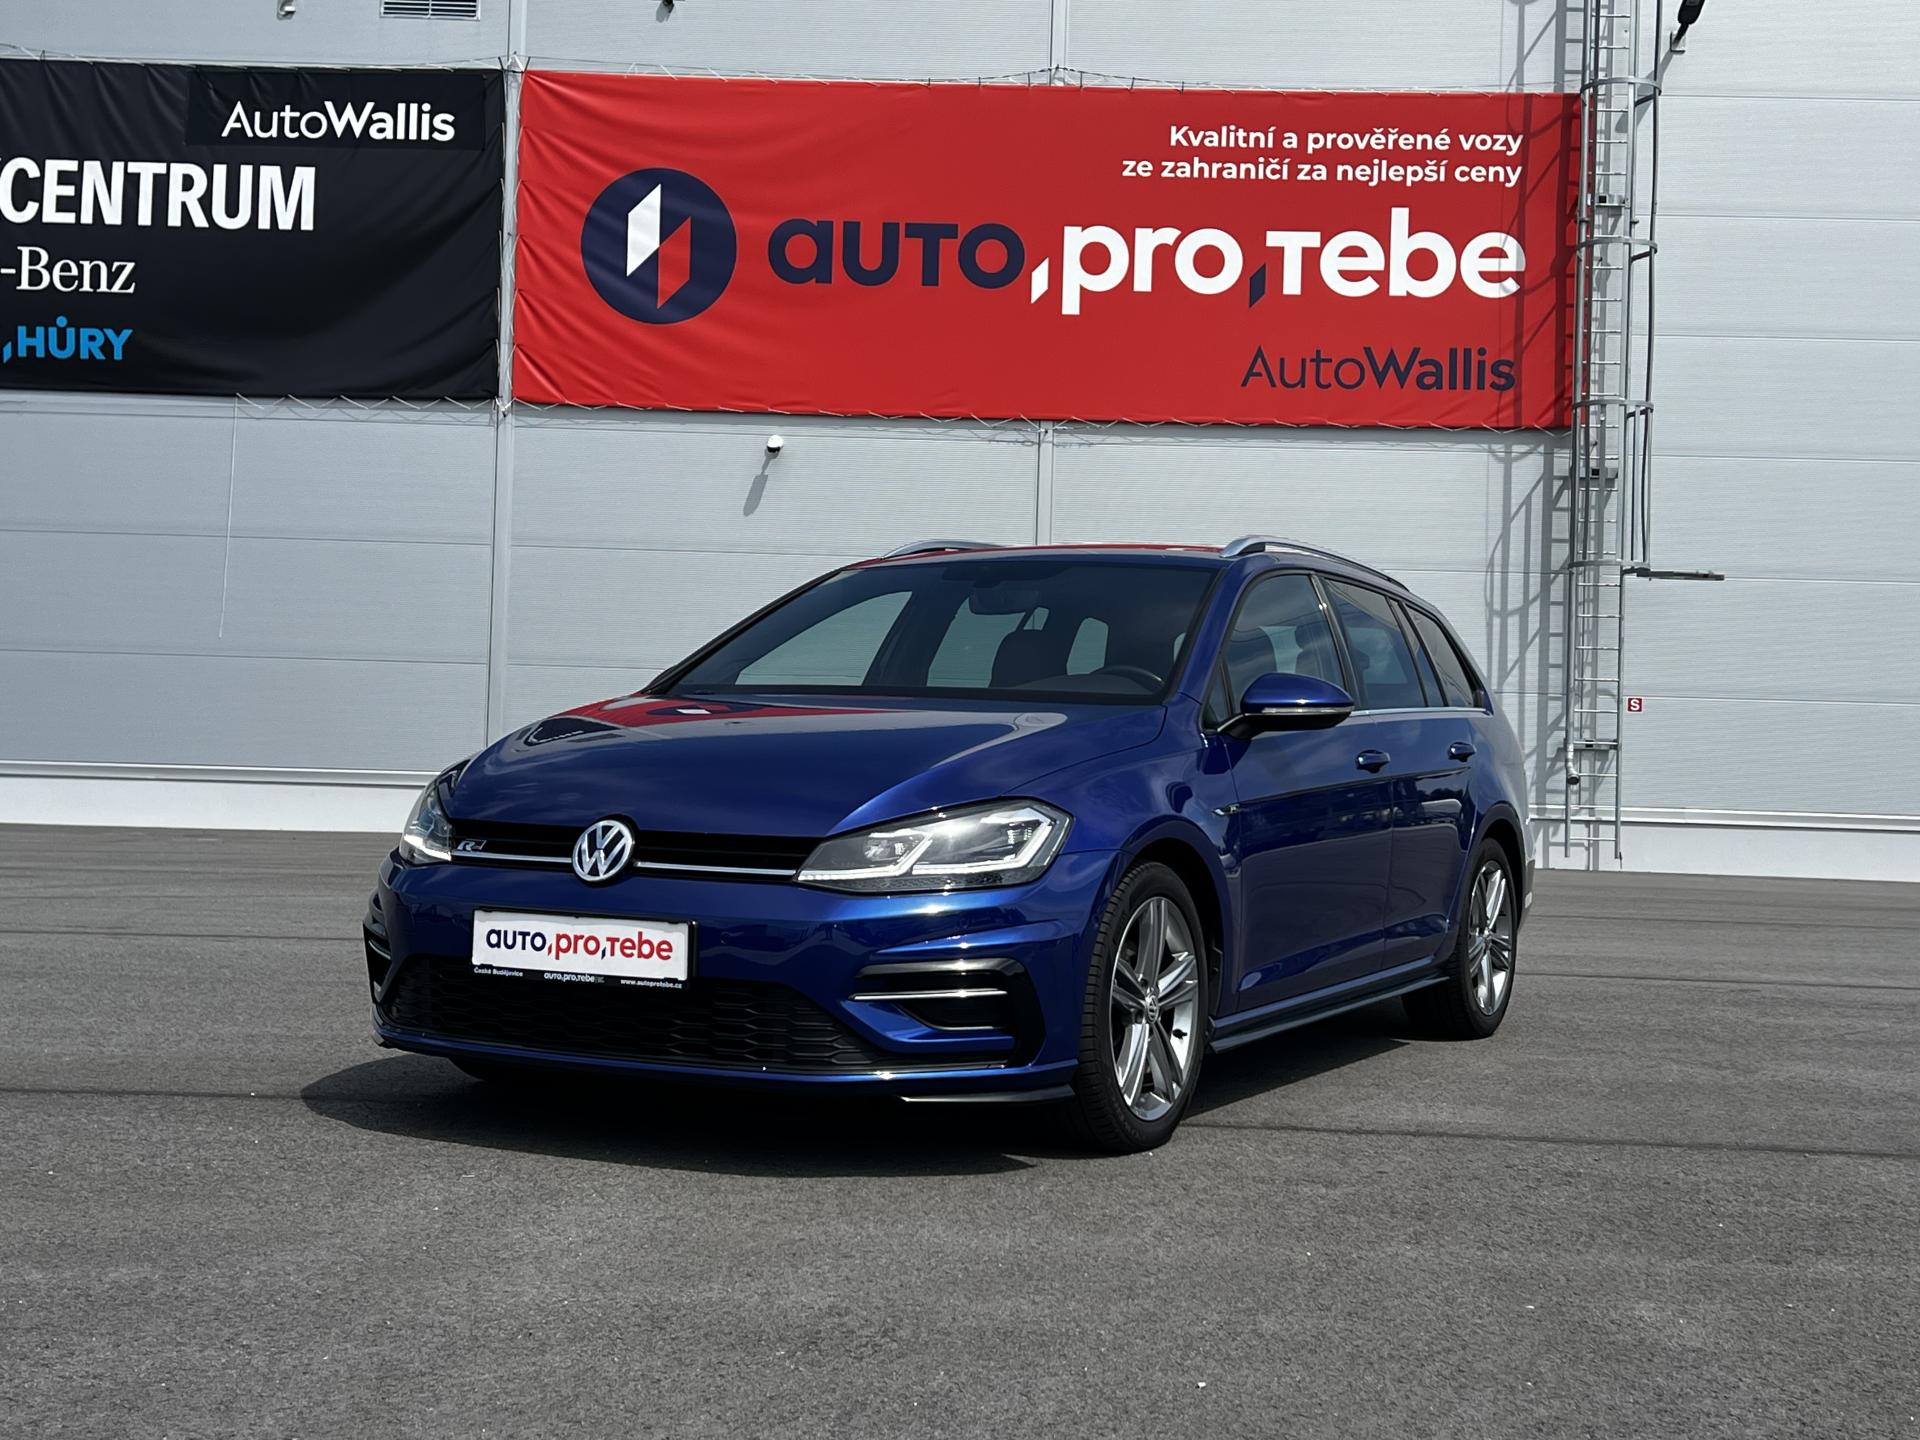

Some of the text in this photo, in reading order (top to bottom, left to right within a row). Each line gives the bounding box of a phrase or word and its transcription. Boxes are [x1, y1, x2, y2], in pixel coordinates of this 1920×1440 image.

[221, 100, 456, 142] AutoWallis
[1170, 125, 1524, 157] Kvalitní a prověřené vozy
[1121, 156, 1523, 188] ze zahraničí za nejlepší ceny
[0, 156, 316, 231] CENTRUM
[1240, 346, 1517, 394] AutoWallis
[1630, 699, 1641, 711] S
